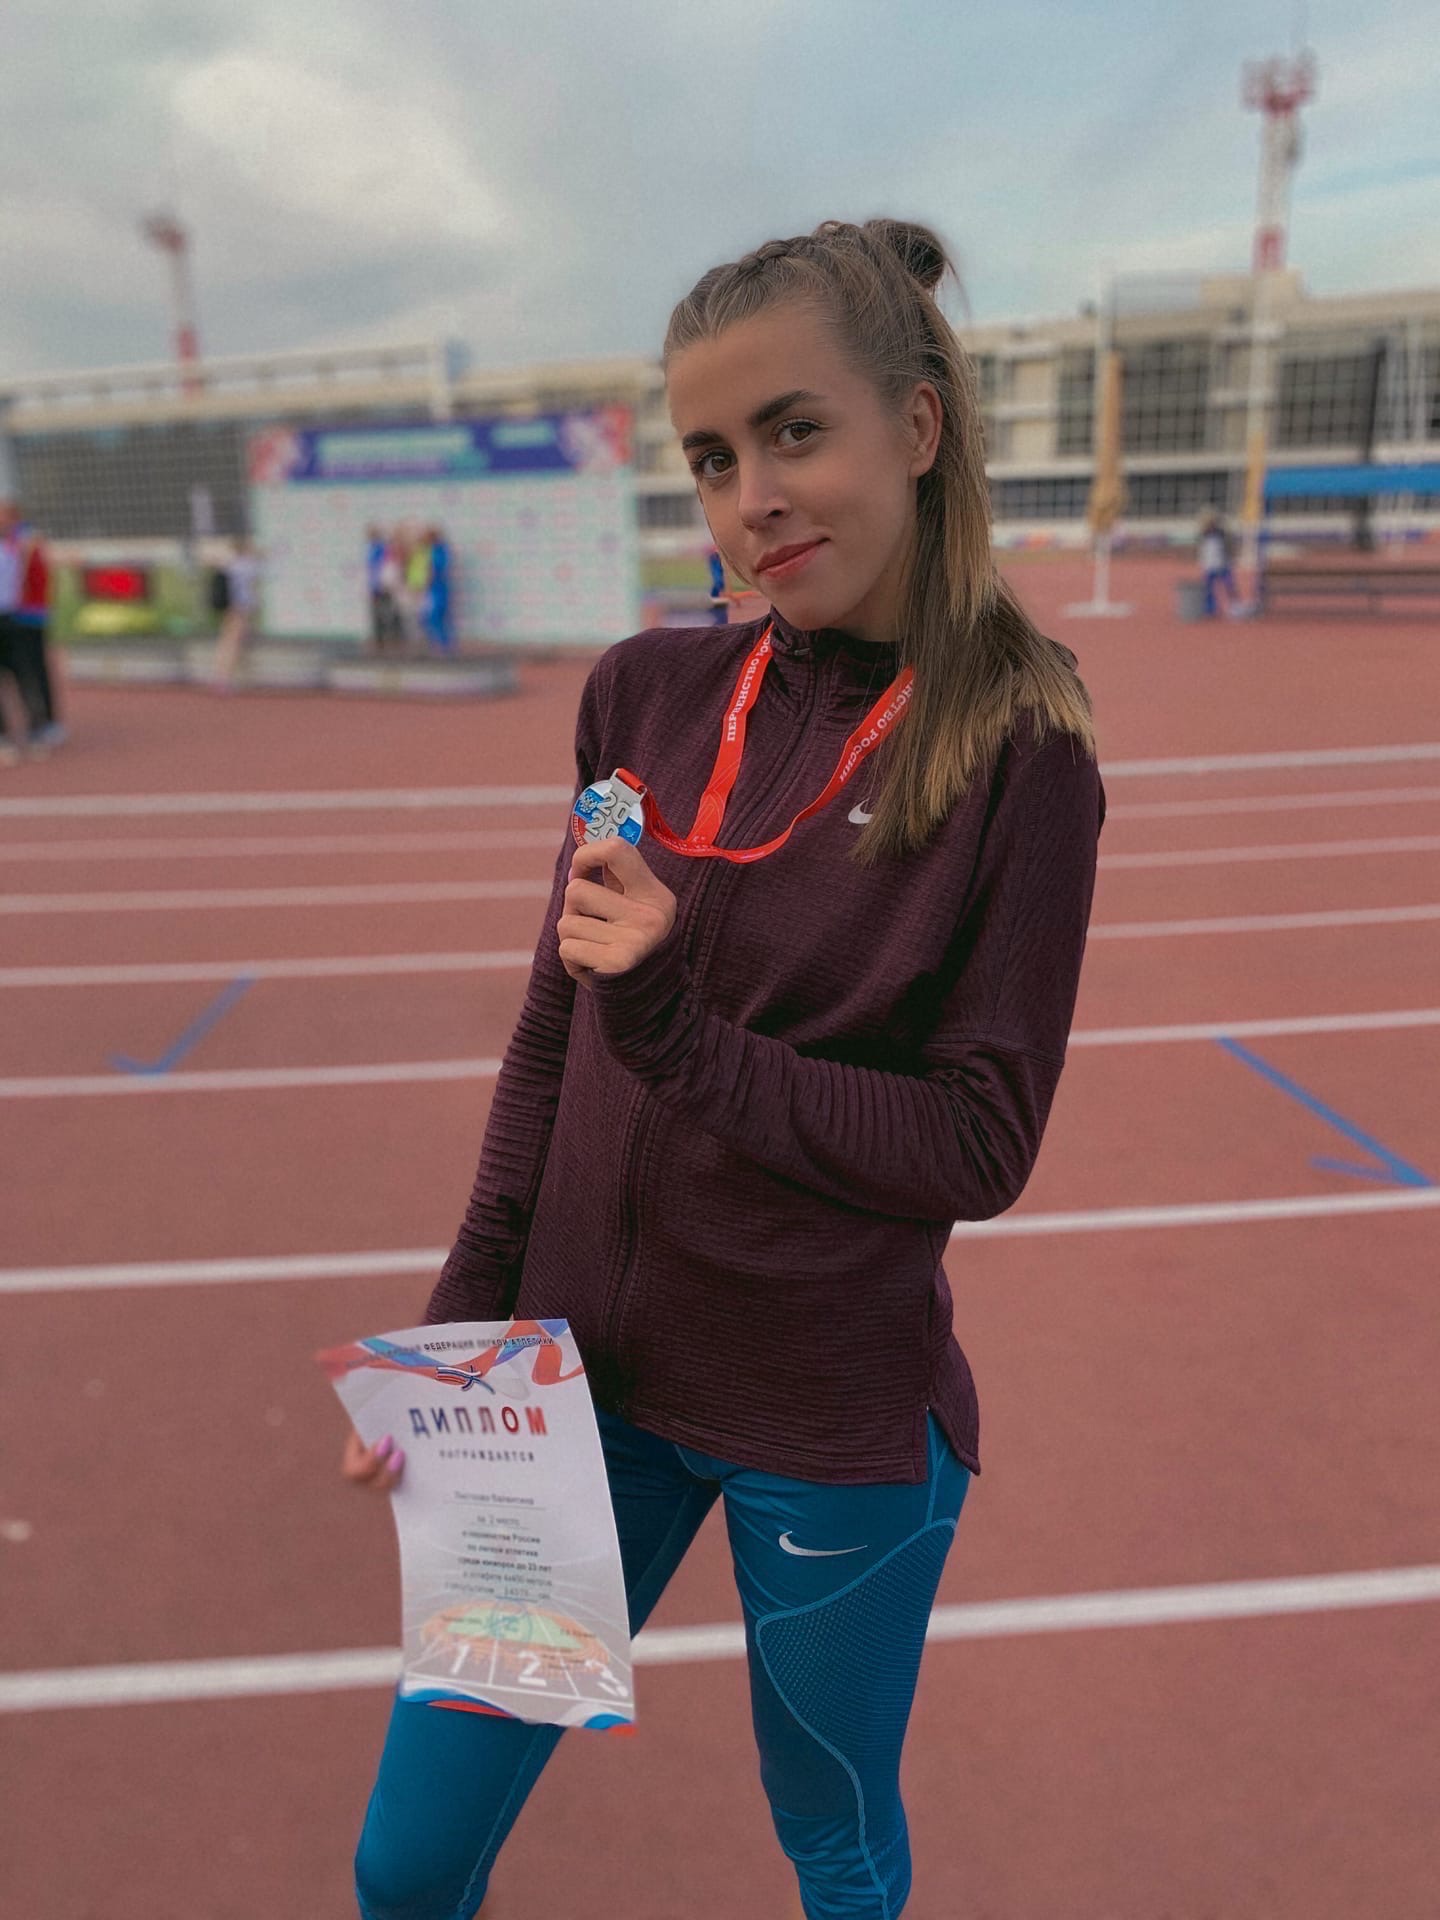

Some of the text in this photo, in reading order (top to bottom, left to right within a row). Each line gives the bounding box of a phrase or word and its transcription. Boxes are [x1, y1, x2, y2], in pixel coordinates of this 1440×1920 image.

[727, 658, 761, 742] ПЕРВЕНСТВО
[839, 680, 914, 782] НСТВО РОССИИ
[408, 1405, 548, 1437] ДИПЛОМ
[516, 1651, 547, 1687] 2
